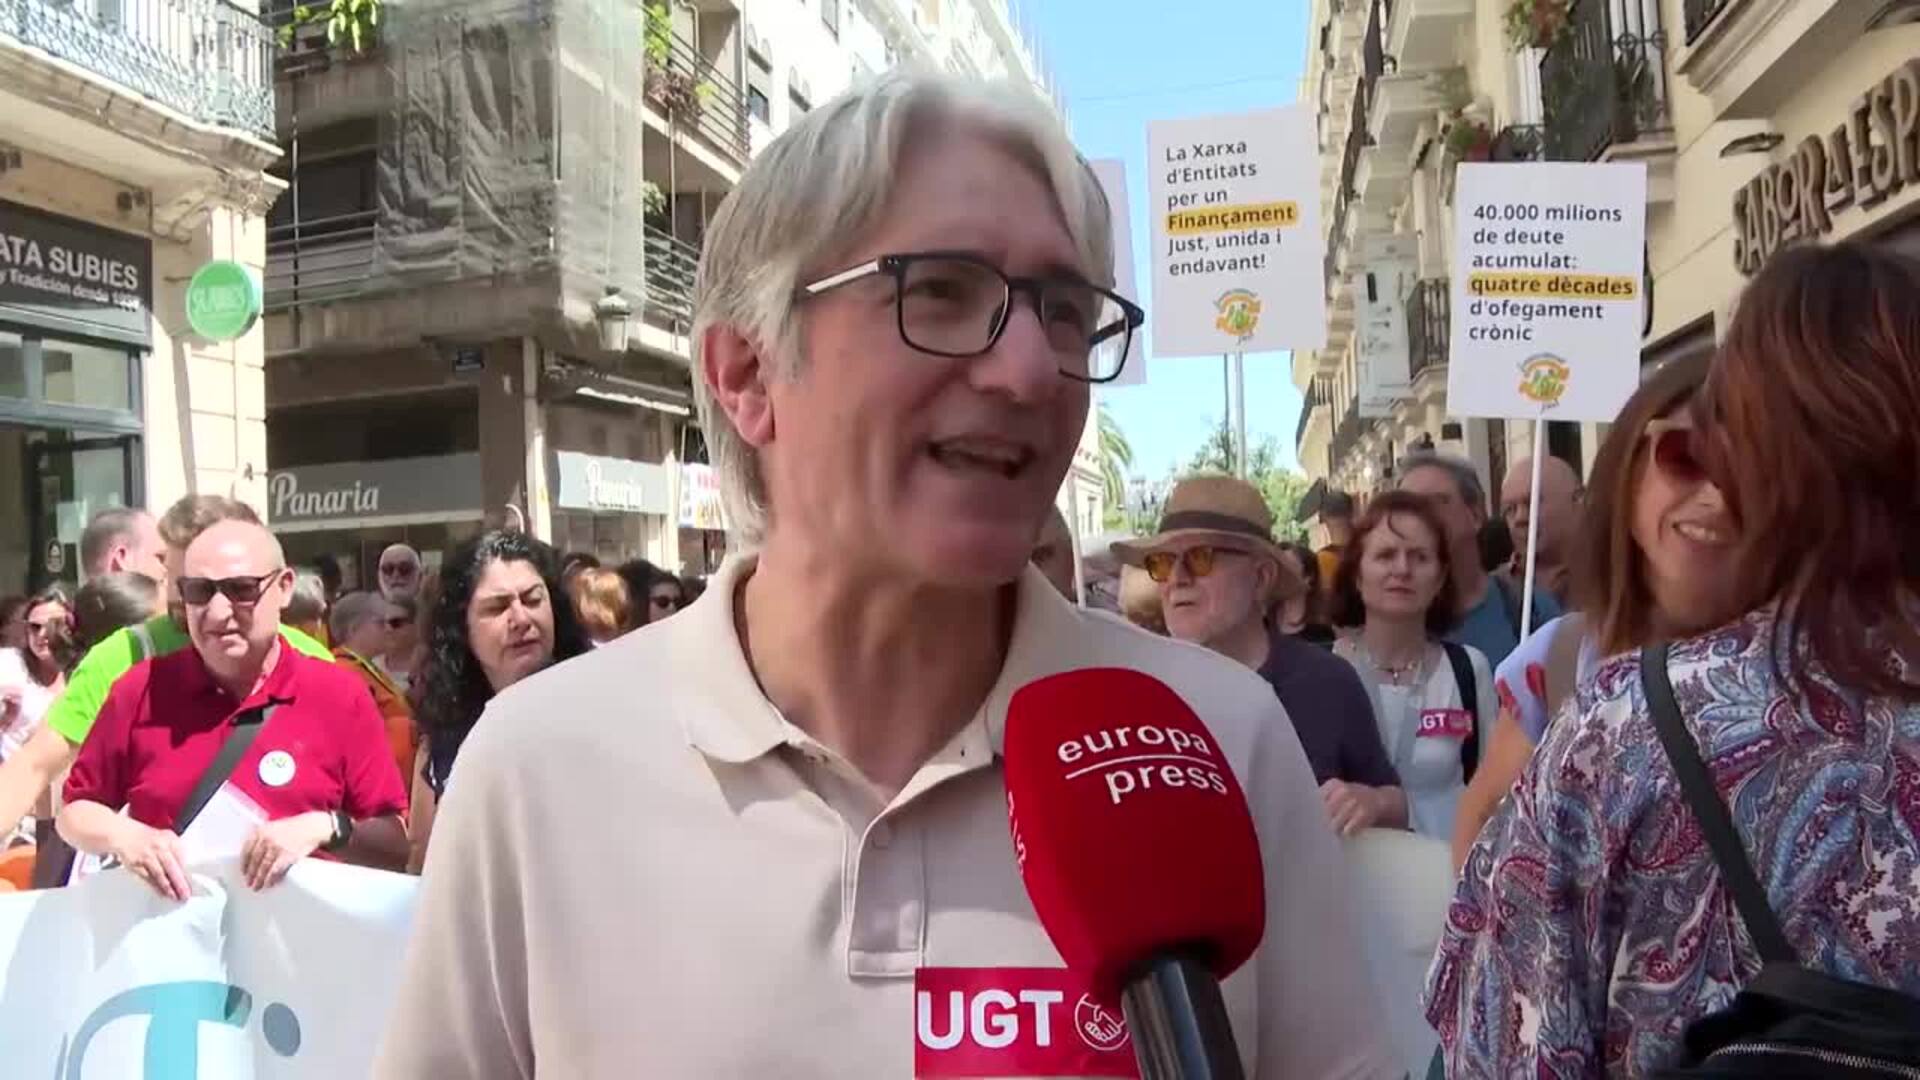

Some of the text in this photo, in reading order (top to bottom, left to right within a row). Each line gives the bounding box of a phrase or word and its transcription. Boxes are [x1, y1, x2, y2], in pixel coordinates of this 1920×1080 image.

[1166, 141, 1248, 162] La Xarxa
[1167, 162, 1257, 184] d'Entitats
[1167, 189, 1228, 211] per un
[1168, 205, 1294, 231] Finançament
[1473, 204, 1622, 222] 40.000 milions
[1168, 228, 1282, 256] Just, unida i
[1473, 228, 1564, 245] de deute
[49, 246, 138, 290] SUBIES
[1169, 254, 1266, 276] endavant!
[1472, 252, 1577, 269] acumulat:
[1471, 275, 1633, 296] quatre dècades
[1470, 300, 1604, 321] d'ofegament
[1469, 324, 1533, 341] crònic
[269, 472, 379, 516] Panaria
[1416, 713, 1446, 730] GT
[1057, 725, 1211, 763] europa
[1104, 764, 1228, 804] press
[917, 989, 1064, 1050] UGT
